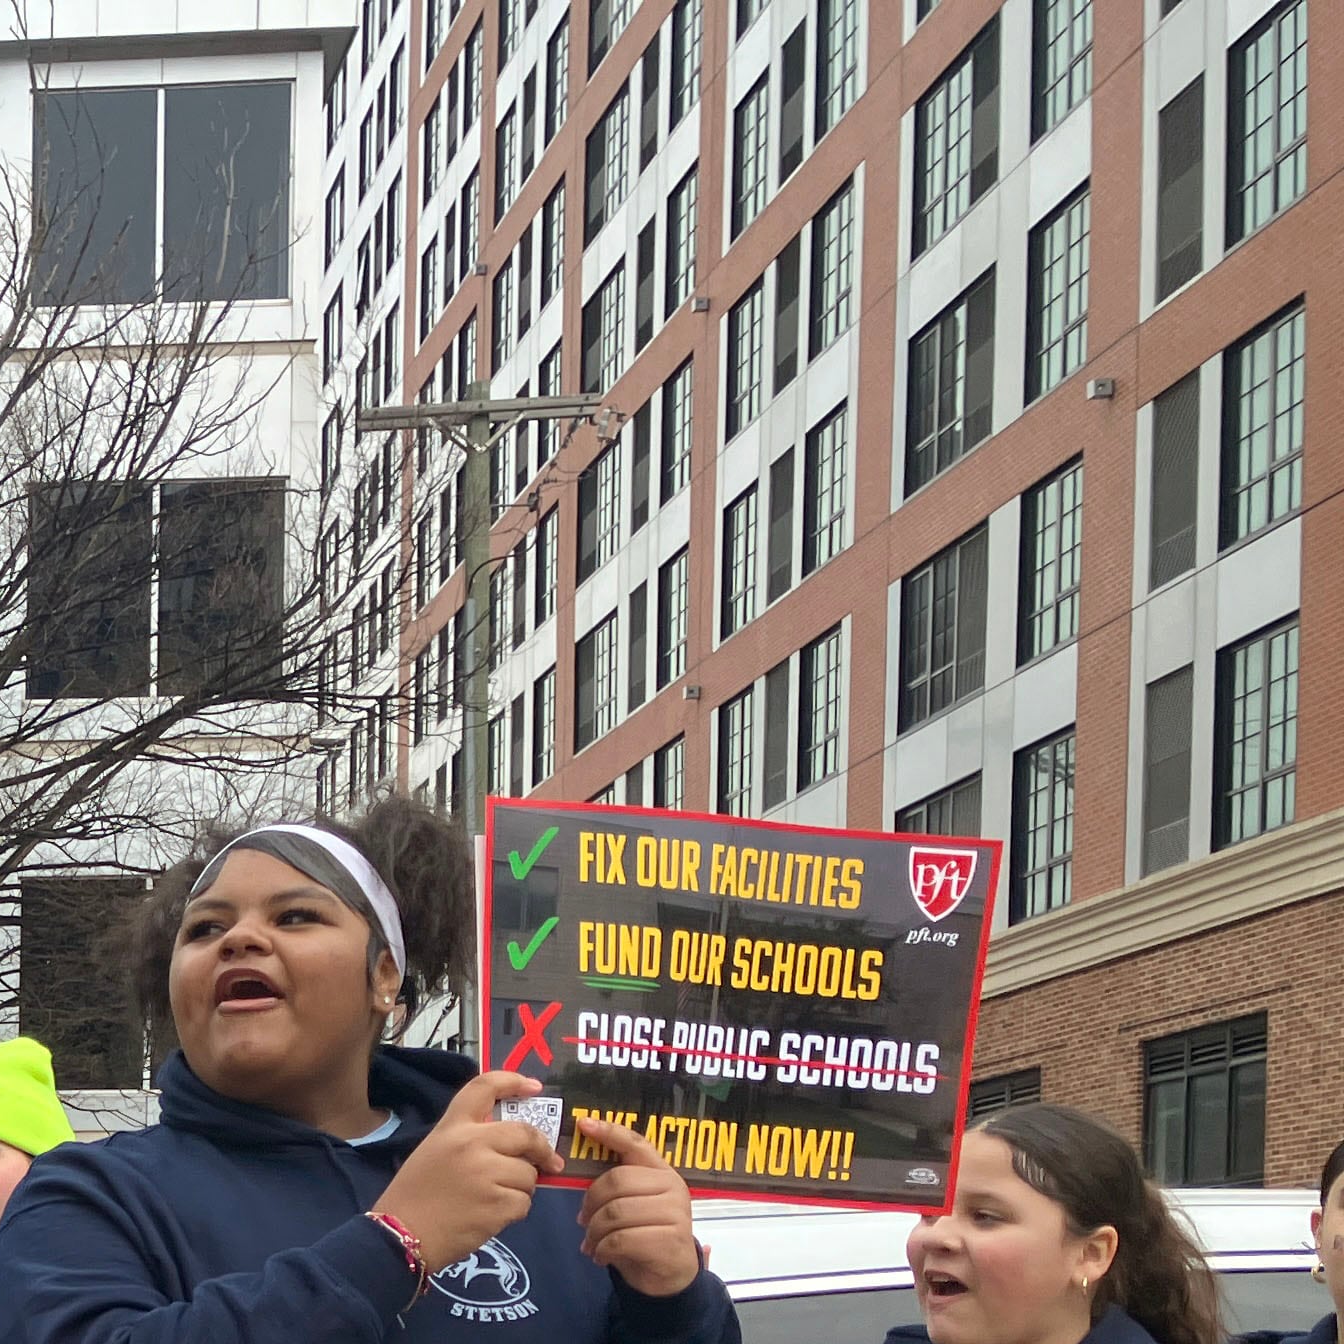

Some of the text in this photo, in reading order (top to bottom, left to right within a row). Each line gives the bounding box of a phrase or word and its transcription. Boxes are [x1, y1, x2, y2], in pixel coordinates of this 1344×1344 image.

[579, 831, 865, 910] FIX OUR FACILITIES
[914, 857, 968, 908] pft
[578, 921, 884, 1002] FUND OUR SCHOOLS
[905, 926, 960, 947] pft.org
[577, 1011, 940, 1095] CLOSE PUBLIC SCHOOLS
[645, 1113, 738, 1172] ACTION
[745, 1123, 855, 1181] NOW!!
[450, 1299, 540, 1322] STETSON
